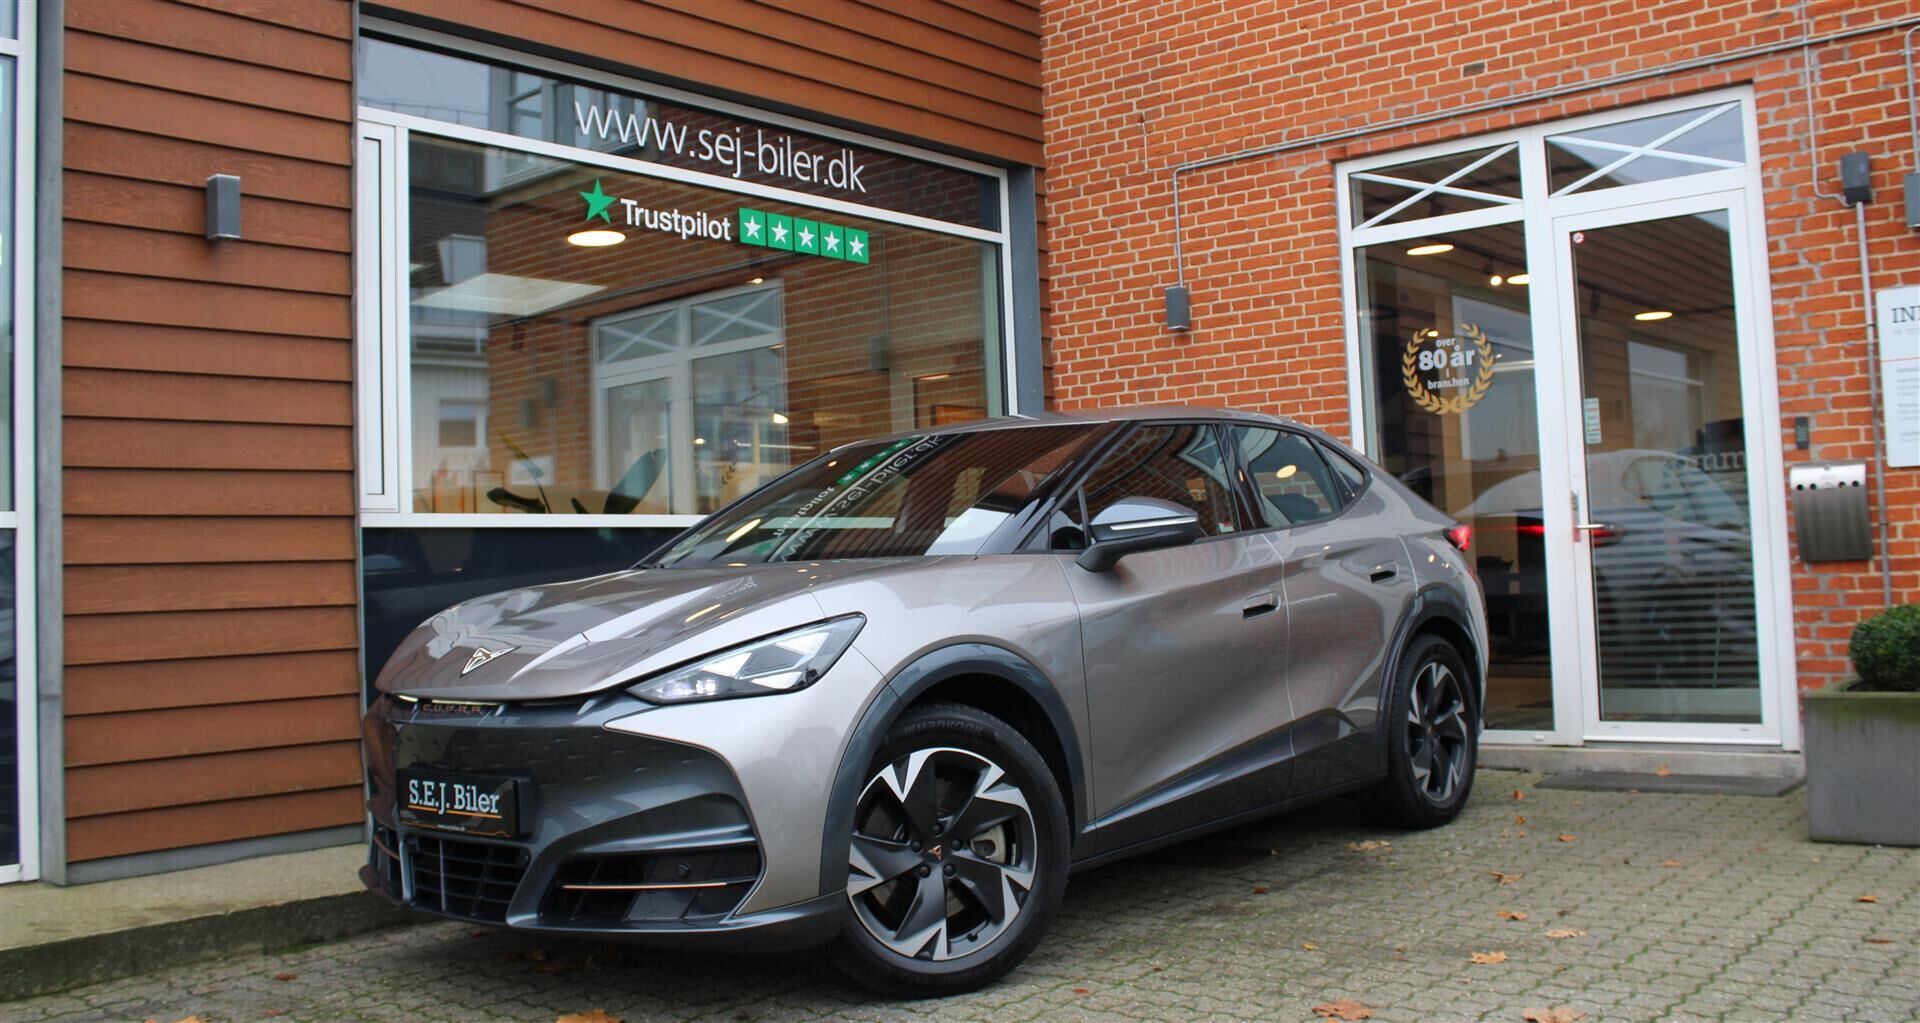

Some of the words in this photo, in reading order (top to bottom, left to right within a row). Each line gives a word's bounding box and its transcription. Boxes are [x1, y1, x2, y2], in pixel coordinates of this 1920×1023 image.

[575, 101, 867, 193] www.sej-biler.dk
[620, 198, 731, 240] Trustpilot
[1891, 305, 1920, 323] IN
[1435, 337, 1456, 347] over
[1418, 349, 1447, 371] 80
[1450, 345, 1475, 367] år
[408, 779, 450, 815] S.E.J.
[453, 784, 500, 814] Biler
